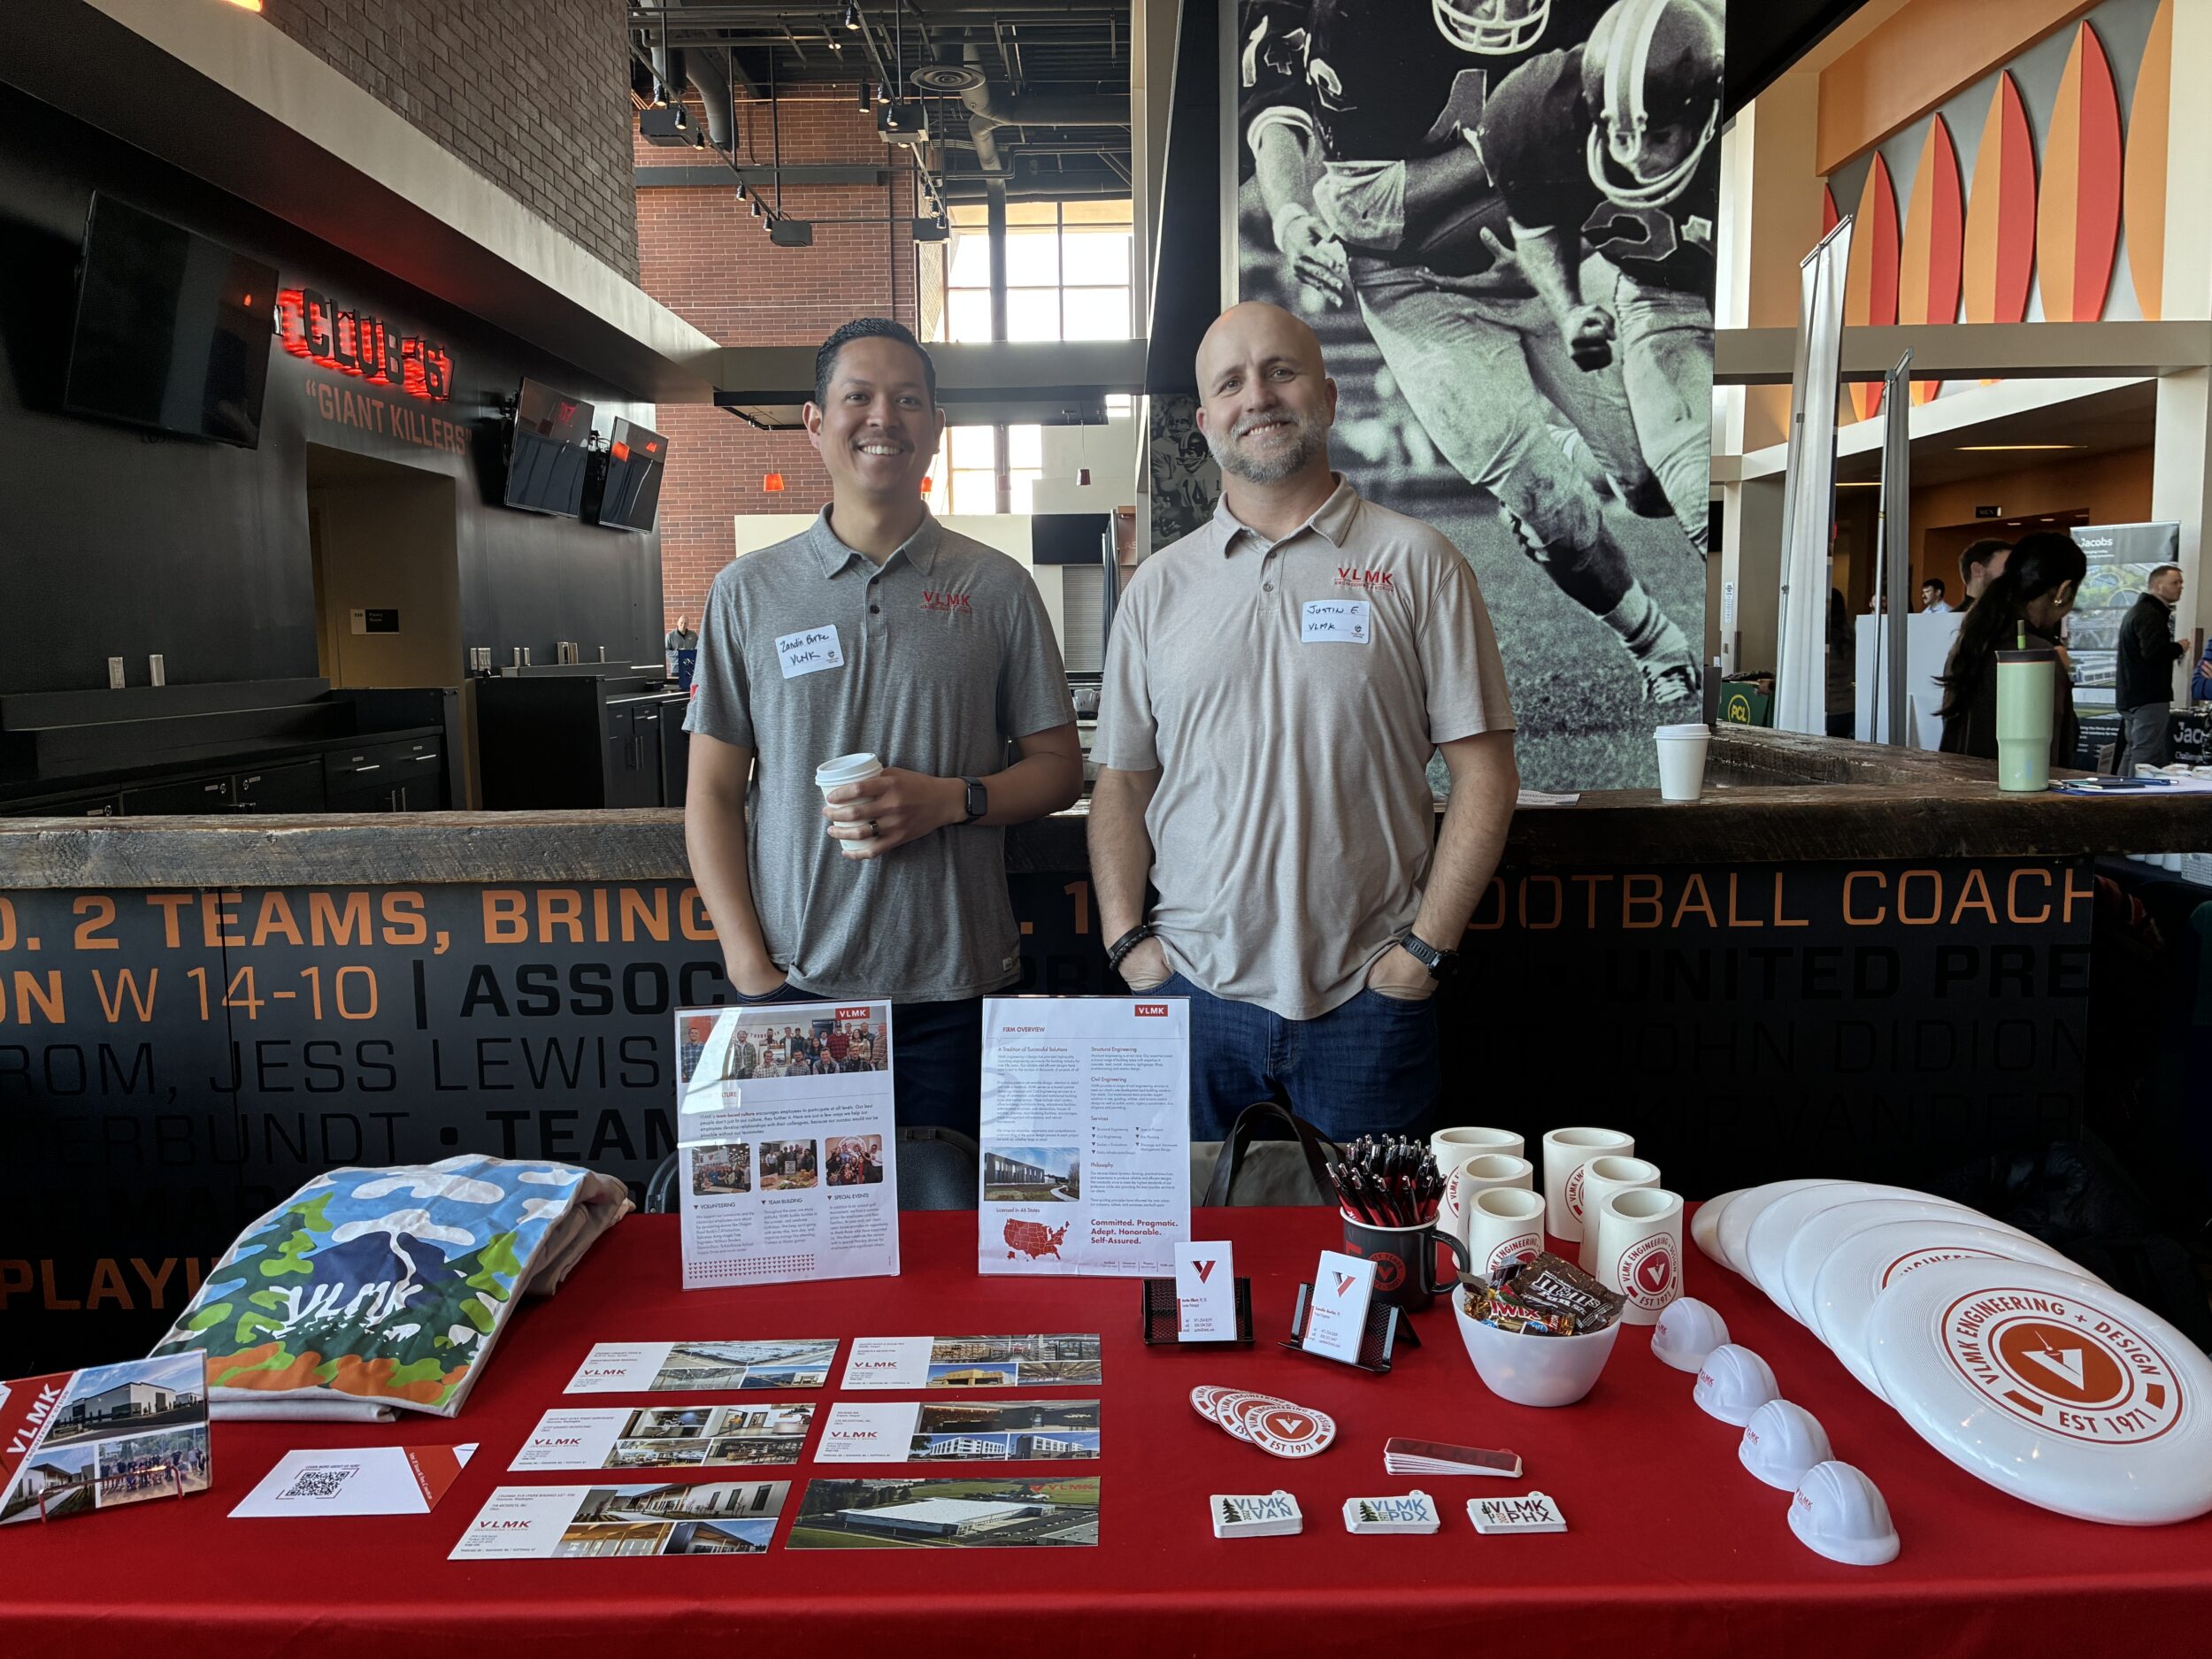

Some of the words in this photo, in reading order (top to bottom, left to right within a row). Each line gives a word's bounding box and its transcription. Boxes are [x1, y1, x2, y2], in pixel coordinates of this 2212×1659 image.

[303, 288, 405, 386] CLUB
[2078, 536, 2114, 548] Jacobs
[1337, 568, 1394, 586] VLMK
[922, 590, 972, 606] VLMK
[1731, 704, 1747, 723] PCL
[1466, 871, 1810, 930] OOTBALL
[73, 895, 119, 950] 2
[147, 890, 449, 955] TEAMS,
[481, 887, 719, 944] BRING
[1605, 946, 1901, 1002] UNITED
[91, 969, 159, 1023] W
[187, 965, 379, 1021] 14-10
[839, 1009, 866, 1018] VLMK
[210, 1038, 398, 1094] JESS
[1570, 1182, 1578, 1202] VLMK
[1090, 1218, 1135, 1227] Committed.
[1137, 1219, 1179, 1228] Pragmatic.
[1090, 1228, 1117, 1237] Adept.
[1496, 1238, 1538, 1259] ENGINEERING
[1622, 1260, 1633, 1282] VLMK
[1628, 1238, 1670, 1262] ENGINEERING
[0, 1257, 217, 1310] PLAYI
[1640, 1296, 1655, 1307] EST
[1656, 1291, 1672, 1306] 1971
[1571, 1304, 1588, 1316] SIZE
[1956, 1296, 2066, 1339] ENGINEERING
[2093, 1320, 2161, 1376] DESIGN
[1957, 1340, 2000, 1385] VLMK
[1221, 1397, 1232, 1412] VLMK
[6, 1383, 62, 1454] VLMK
[26, 1420, 53, 1462] ENGINEERING
[54, 1391, 70, 1413] DESIGN
[1249, 1413, 1259, 1429] VLMK
[1254, 1405, 1309, 1414] ENGINEERING
[1316, 1414, 1332, 1433] DESIGN
[2059, 1411, 2098, 1433] EST
[2104, 1408, 2157, 1435] 1971
[1270, 1440, 1286, 1453] EST
[1290, 1442, 1315, 1454] 1971
[1233, 1497, 1290, 1511] VLMK
[1371, 1499, 1428, 1512] VLMK
[1487, 1500, 1548, 1513] VLMK
[1798, 1490, 1814, 1509] VLMK
[1251, 1508, 1294, 1520] VAN
[1389, 1511, 1430, 1522] PDX
[1506, 1511, 1555, 1524] PHX
